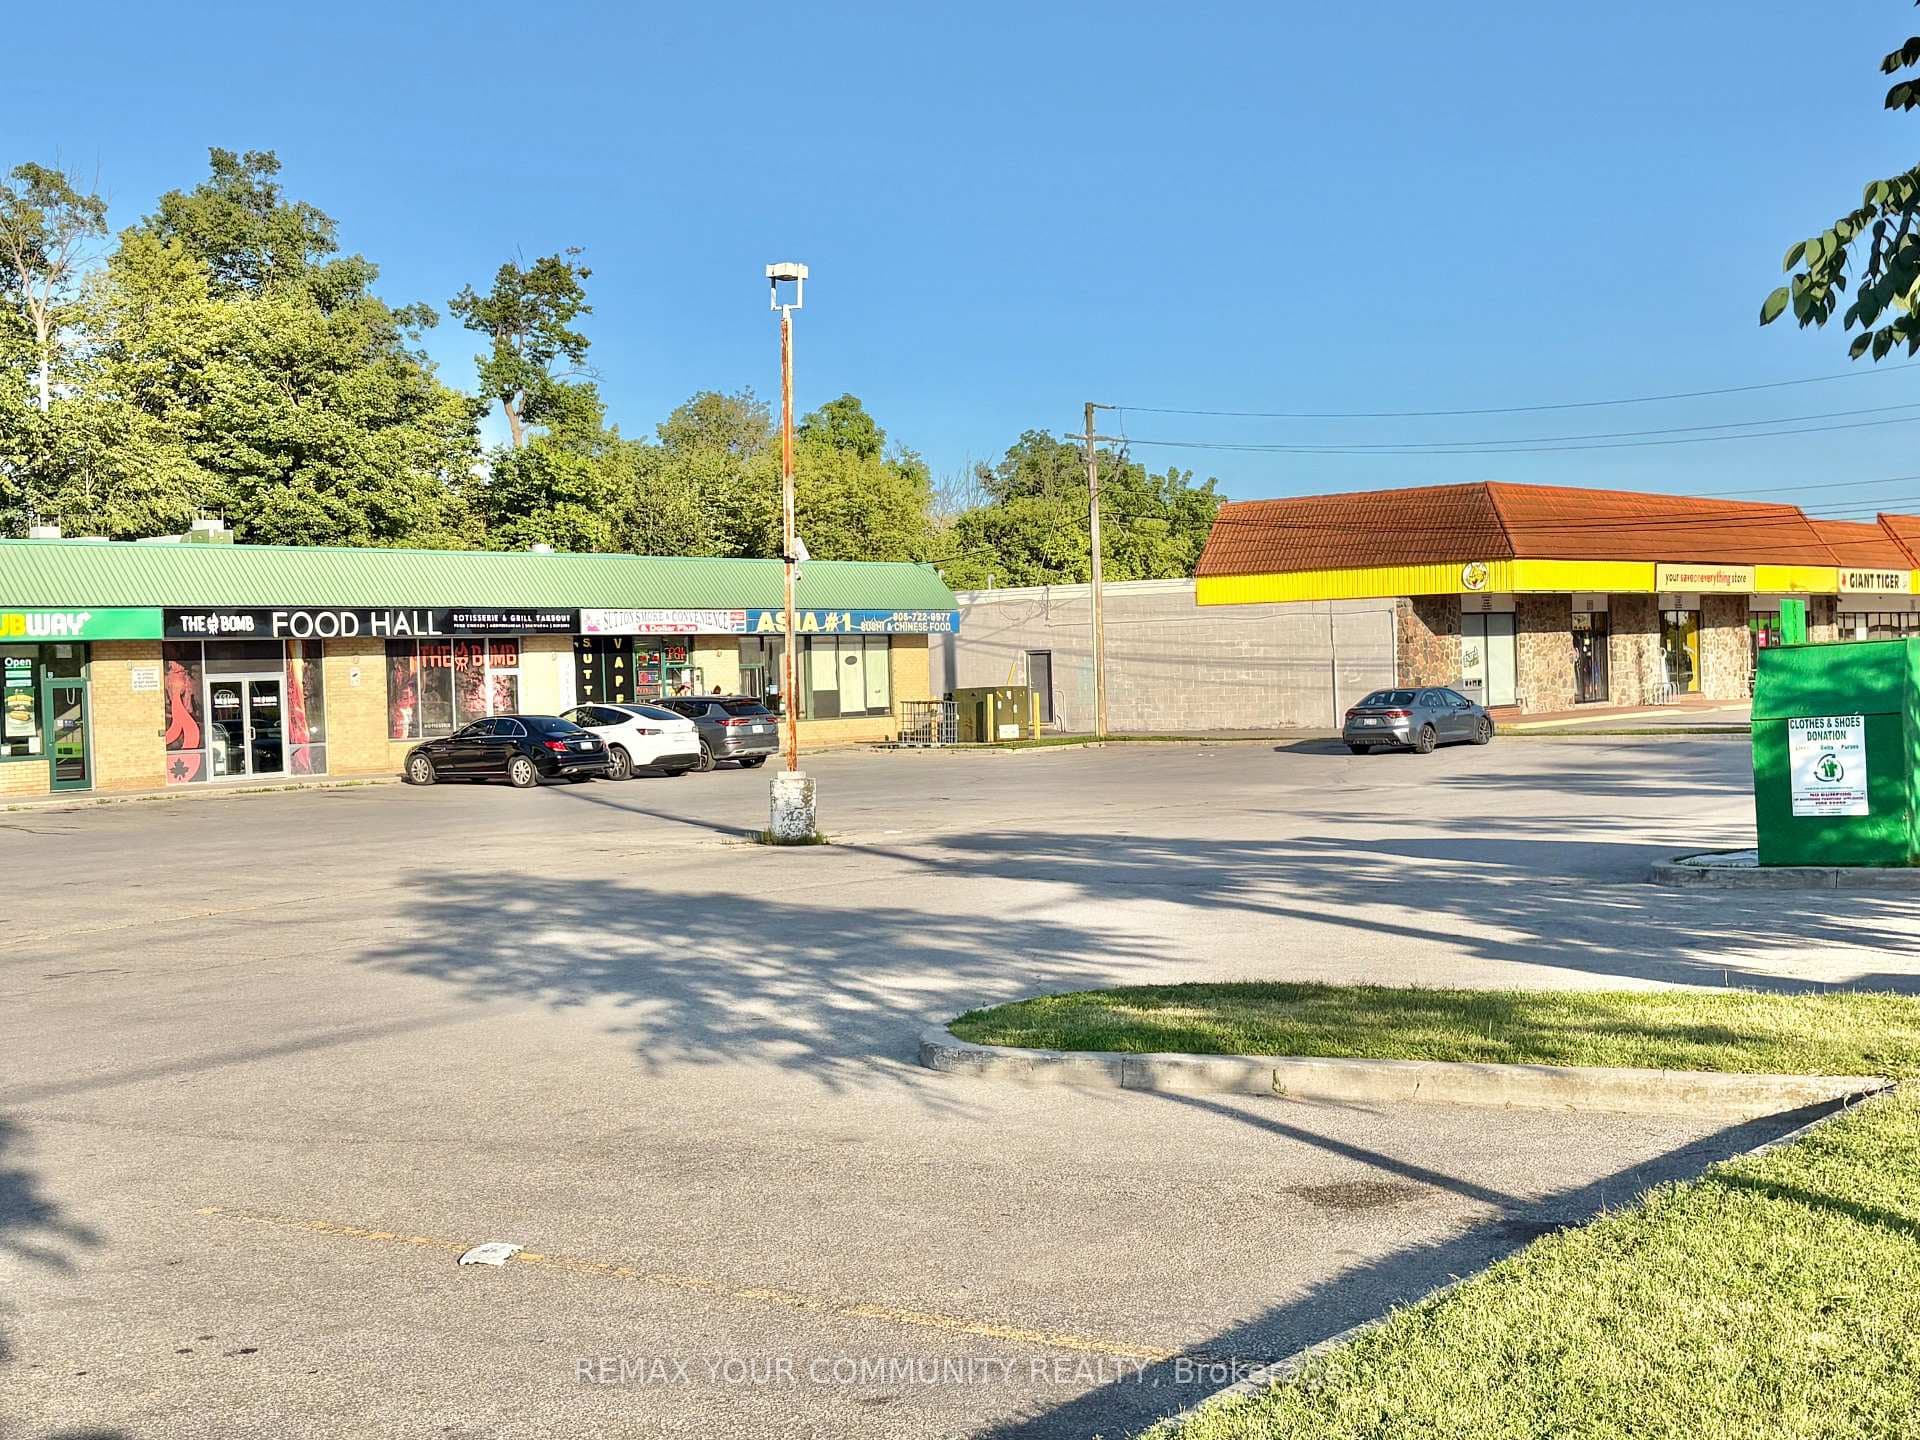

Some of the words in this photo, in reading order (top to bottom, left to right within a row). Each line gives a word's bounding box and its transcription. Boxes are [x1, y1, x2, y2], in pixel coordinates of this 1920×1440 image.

[1665, 573, 1679, 585] your
[1731, 572, 1747, 583] store
[1850, 573, 1874, 588] GIANT
[1876, 574, 1900, 588] TIGER
[0, 612, 92, 636] UBWAY
[180, 615, 206, 632] THE
[220, 615, 255, 632] BOMB
[272, 611, 360, 638] FOOD
[370, 610, 442, 637] HALL
[453, 614, 499, 622] ROTISSERIE
[510, 614, 532, 622] GRILL
[603, 611, 634, 630] SUTTON
[635, 611, 663, 624] SMOKE
[671, 610, 728, 630] CONVENIENCE
[757, 611, 819, 633] ASIA
[824, 611, 851, 633] #1
[894, 622, 928, 632] CHINESE
[929, 622, 951, 632] FOOD
[4, 657, 32, 668] Open
[421, 645, 452, 667] THE
[582, 638, 594, 705] SUTT
[1789, 719, 1825, 729] CLOTHES
[1826, 718, 1833, 728] &
[1834, 717, 1861, 727] SHOES
[1807, 730, 1847, 741] DONATION
